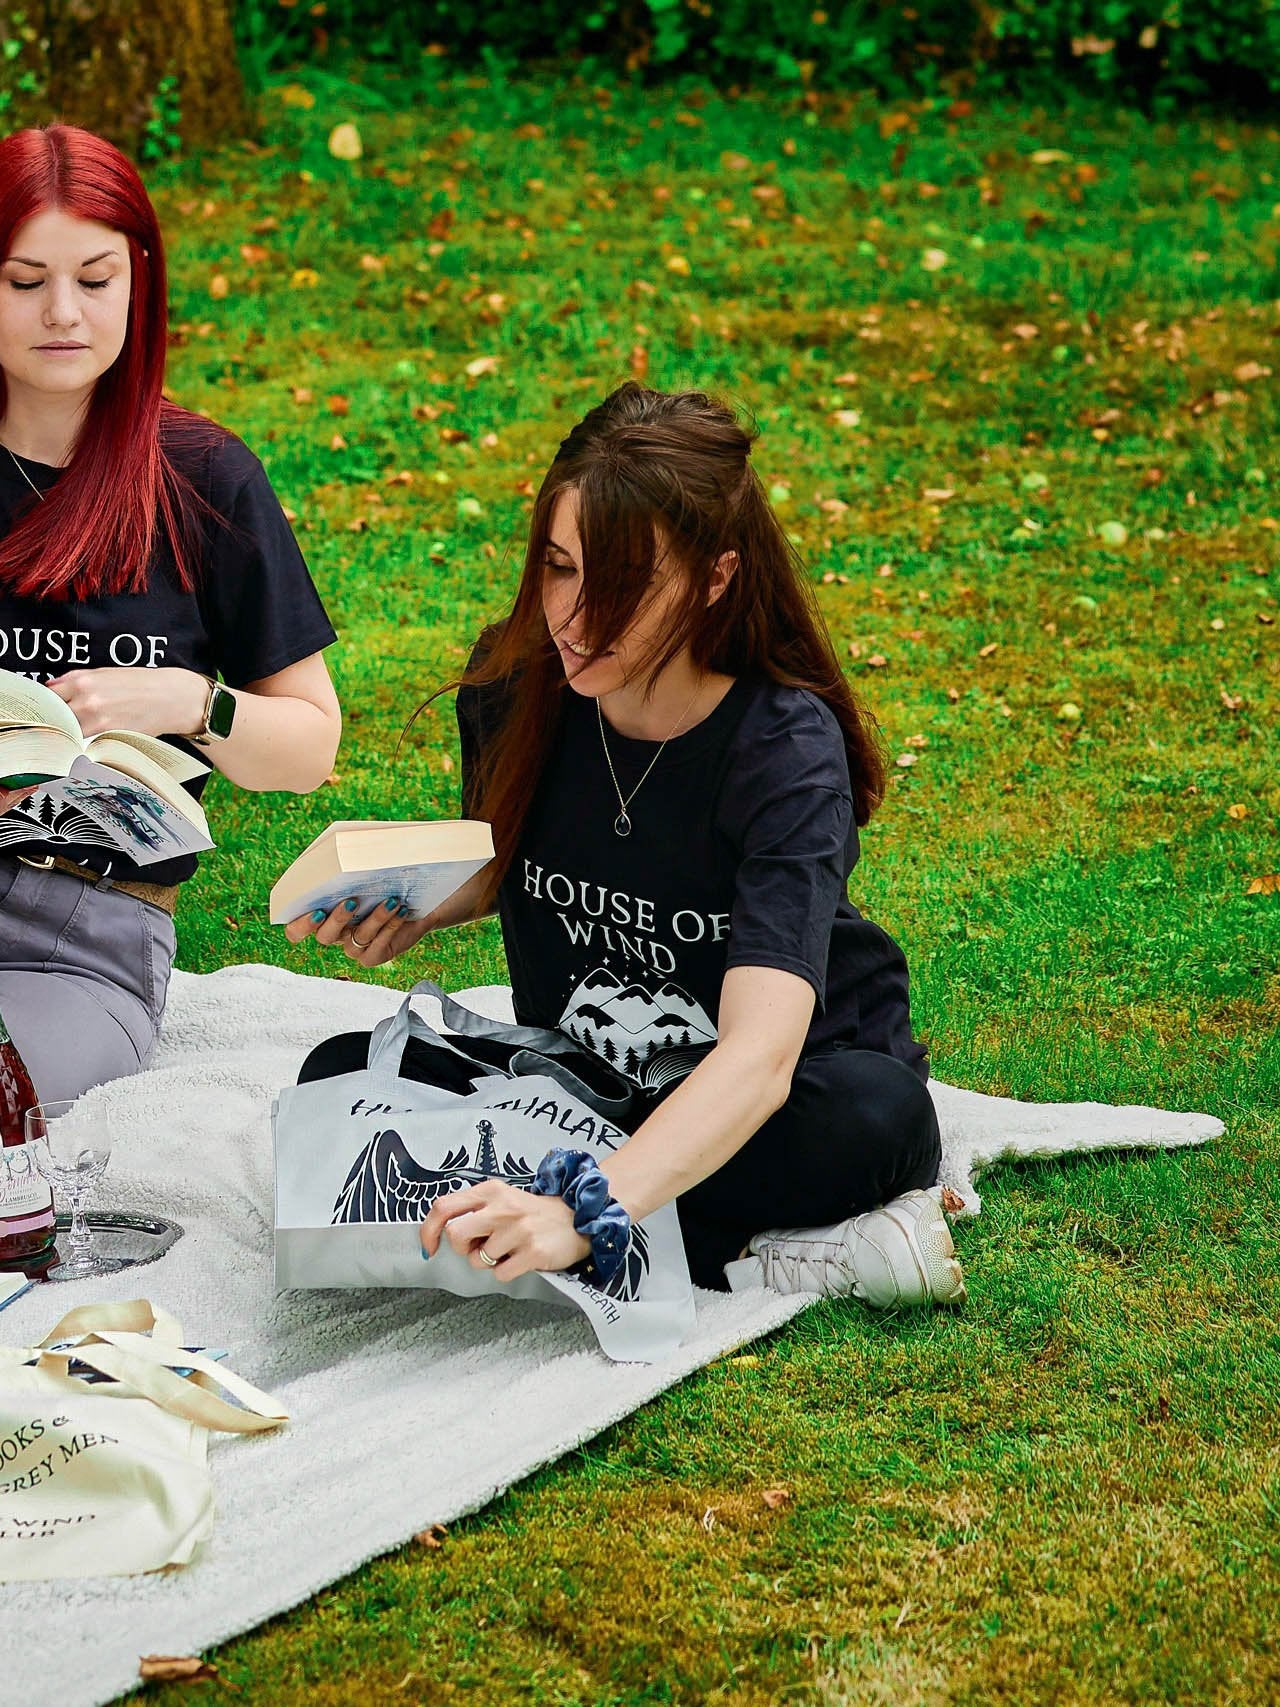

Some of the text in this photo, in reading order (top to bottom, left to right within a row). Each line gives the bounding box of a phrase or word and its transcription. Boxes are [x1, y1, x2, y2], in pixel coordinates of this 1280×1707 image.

[109, 634, 168, 668] OF
[524, 859, 731, 942] HOUSE OF
[556, 912, 676, 973] WIND
[52, 1415, 71, 1427] &
[59, 1432, 119, 1464] MEN
[12, 1514, 95, 1527] WIND
